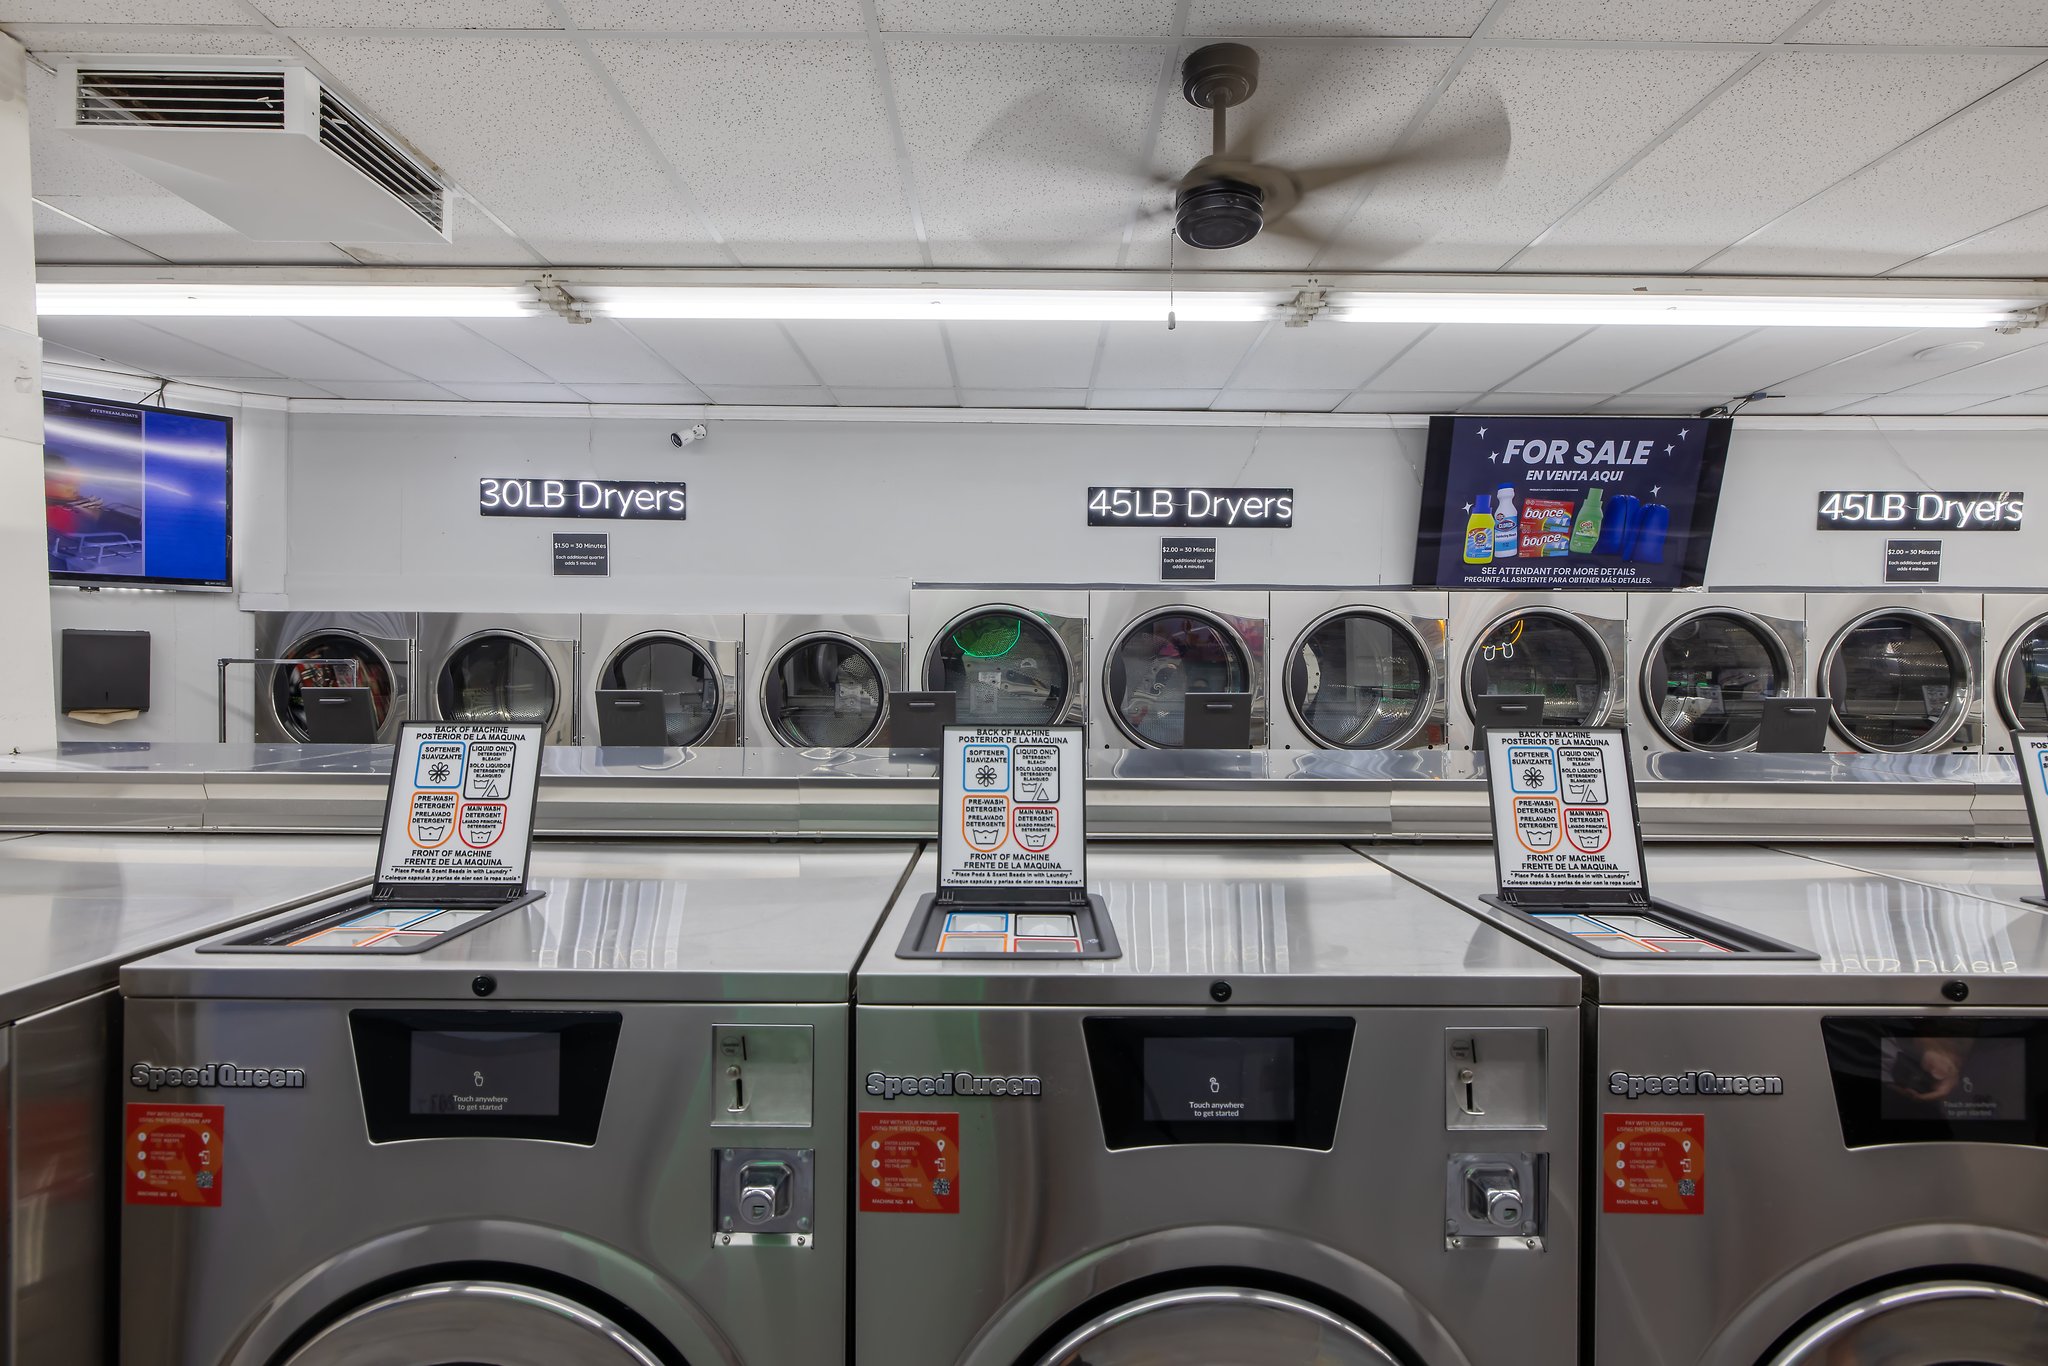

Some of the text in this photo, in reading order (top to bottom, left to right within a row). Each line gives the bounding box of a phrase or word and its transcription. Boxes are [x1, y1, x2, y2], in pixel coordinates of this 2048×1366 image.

[1503, 439, 1654, 465] FOR SALE
[1526, 470, 1624, 481] EN VENTA AQUI
[481, 479, 684, 517] 30LB Dryers
[1089, 490, 1292, 525] 45LB Dryers
[1819, 493, 2024, 528] 45LB Dryers
[1524, 507, 1564, 520] bounce
[1523, 533, 1561, 547] bounce
[1481, 567, 1636, 576] SEE ATTENDANT FOR MORE DETAILS
[131, 1063, 305, 1091] Speed Queen
[866, 1072, 1042, 1099] Speed Queen
[1609, 1072, 1783, 1099] Speed Queen
[474, 1096, 508, 1104] anywhere
[1211, 1102, 1244, 1110] anywhere
